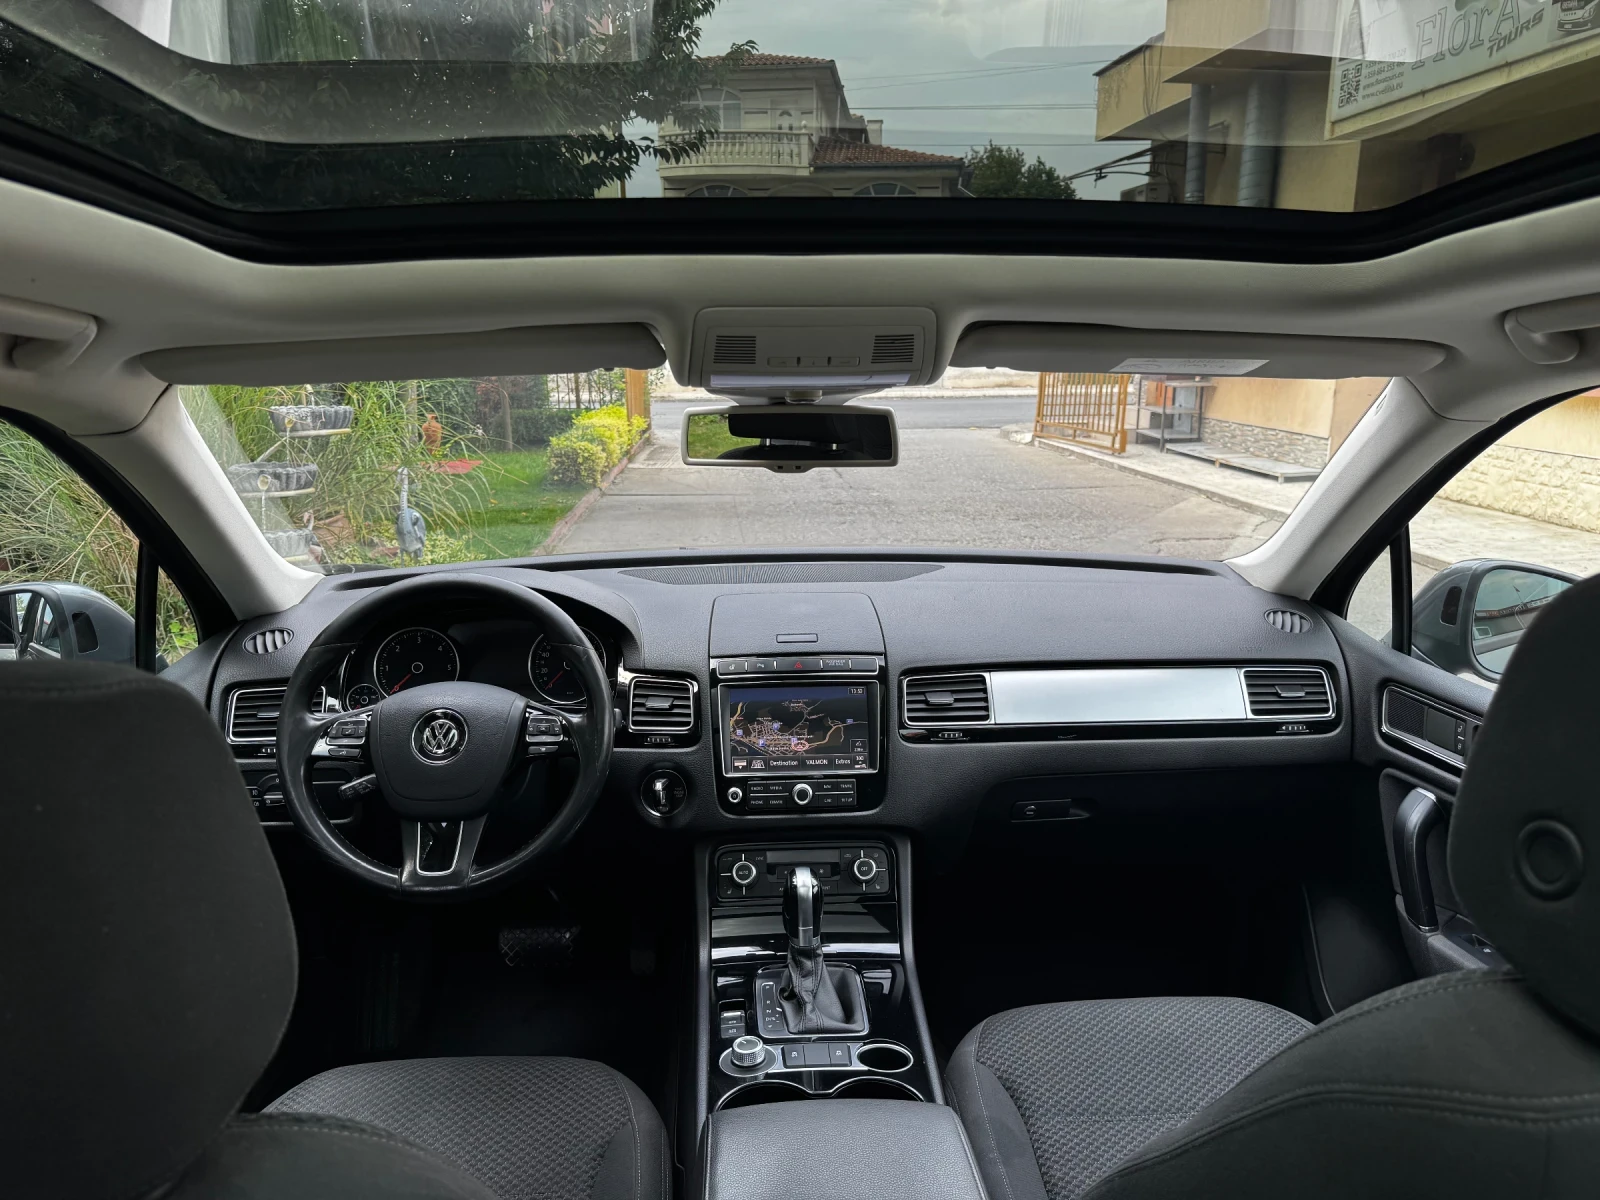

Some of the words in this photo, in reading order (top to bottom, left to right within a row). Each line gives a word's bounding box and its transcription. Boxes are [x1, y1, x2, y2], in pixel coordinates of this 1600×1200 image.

[1487, 7, 1545, 58] TOURS
[423, 719, 457, 753] VW
[769, 759, 799, 767] Destination
